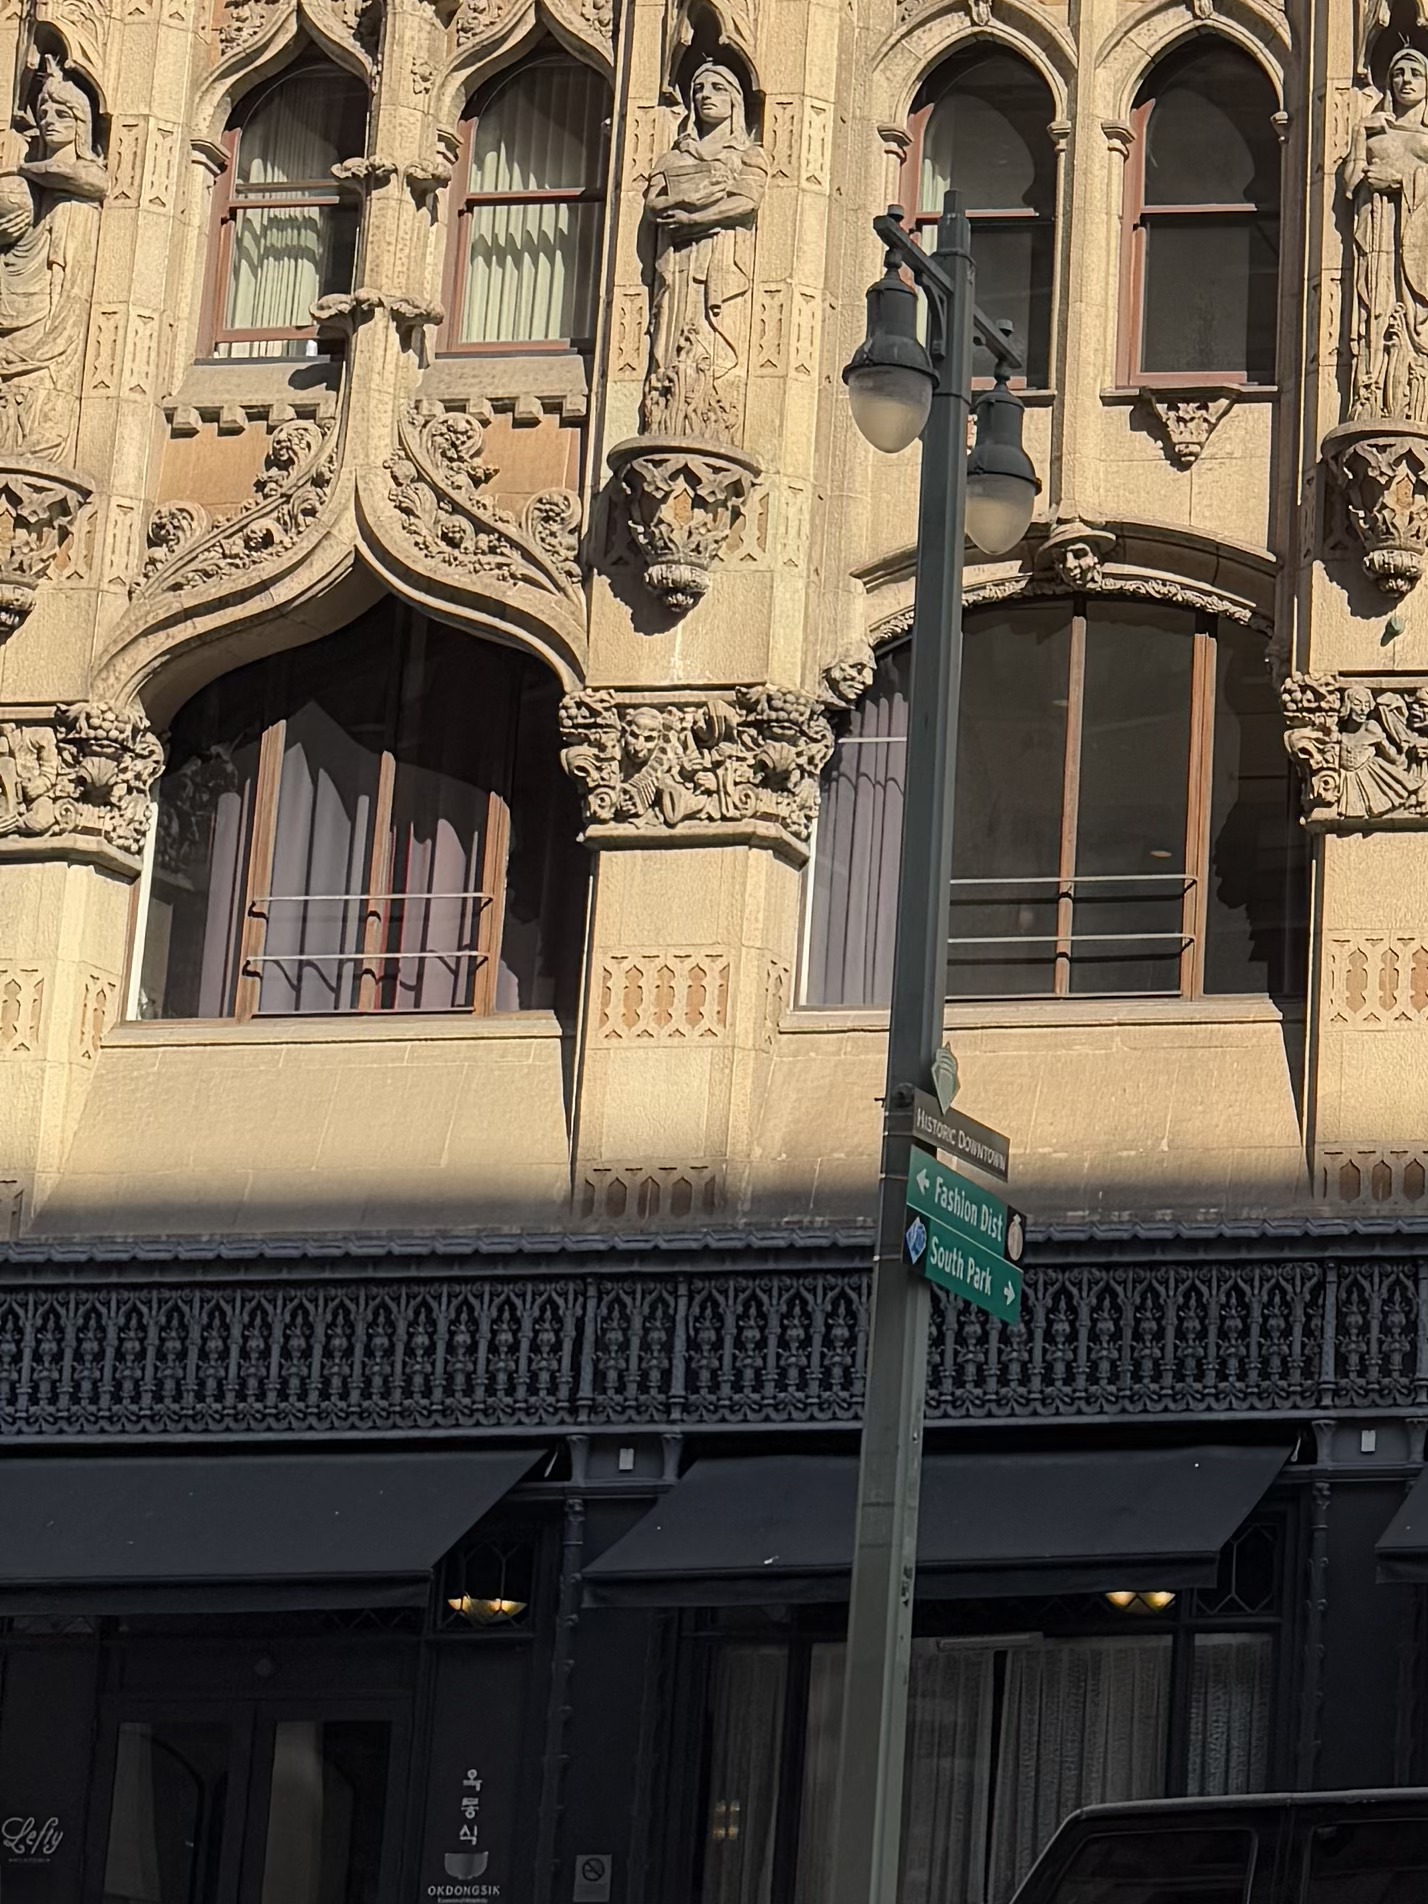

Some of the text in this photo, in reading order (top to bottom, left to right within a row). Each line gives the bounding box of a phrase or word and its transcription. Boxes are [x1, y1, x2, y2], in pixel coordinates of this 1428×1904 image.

[916, 1107, 1006, 1171] HISTORIC DOWNTOWN
[934, 1175, 1004, 1243] Fashion Dist
[930, 1235, 992, 1296] South Park
[427, 1885, 500, 1896] OKDONGSIK
